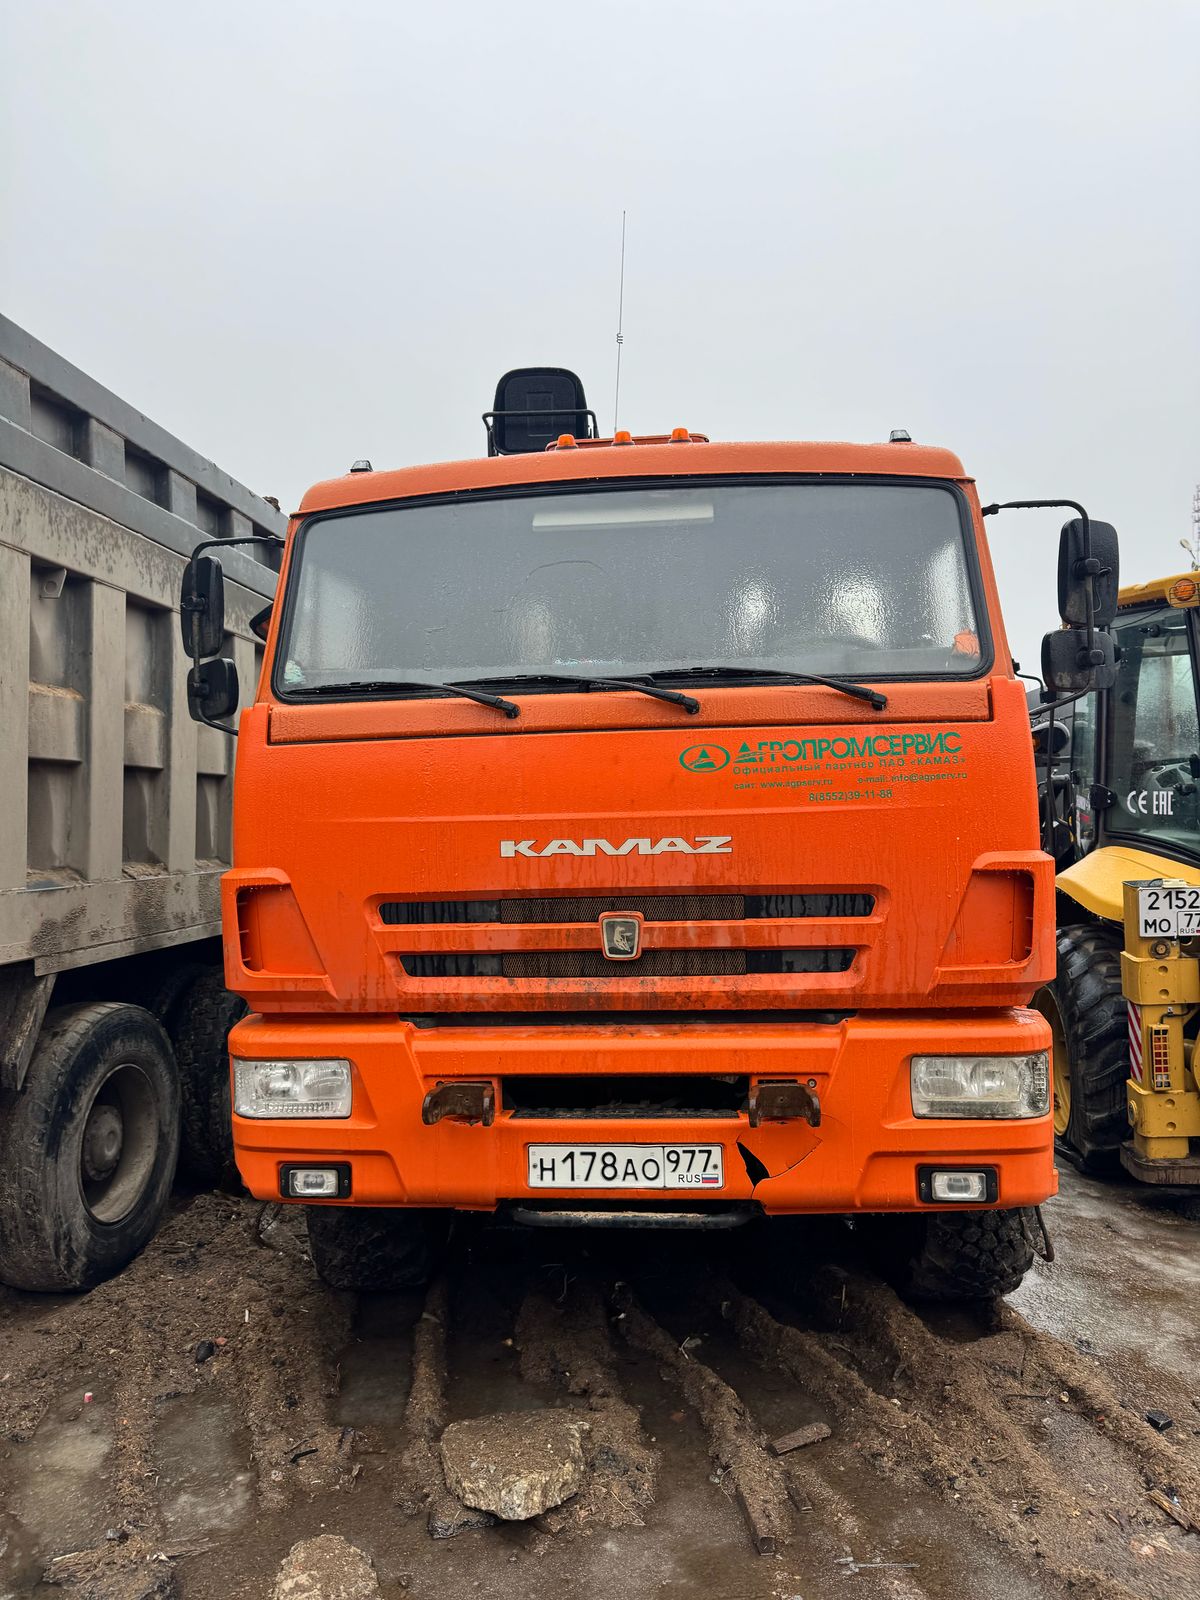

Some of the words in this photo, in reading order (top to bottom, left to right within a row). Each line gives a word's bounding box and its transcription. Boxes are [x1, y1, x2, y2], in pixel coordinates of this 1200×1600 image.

[734, 732, 962, 763] АГРОПРОМСЕРВИС
[733, 764, 820, 775] Официальный
[825, 762, 874, 771] партнер
[879, 757, 905, 768] ПАО
[910, 755, 967, 766] «КАМАЗ»
[809, 789, 892, 802] 8(8552)39-11-88
[500, 836, 733, 858] KAMAZ
[1147, 890, 1200, 911] 2152
[666, 1149, 713, 1173] 977
[678, 1174, 701, 1184] RUS
